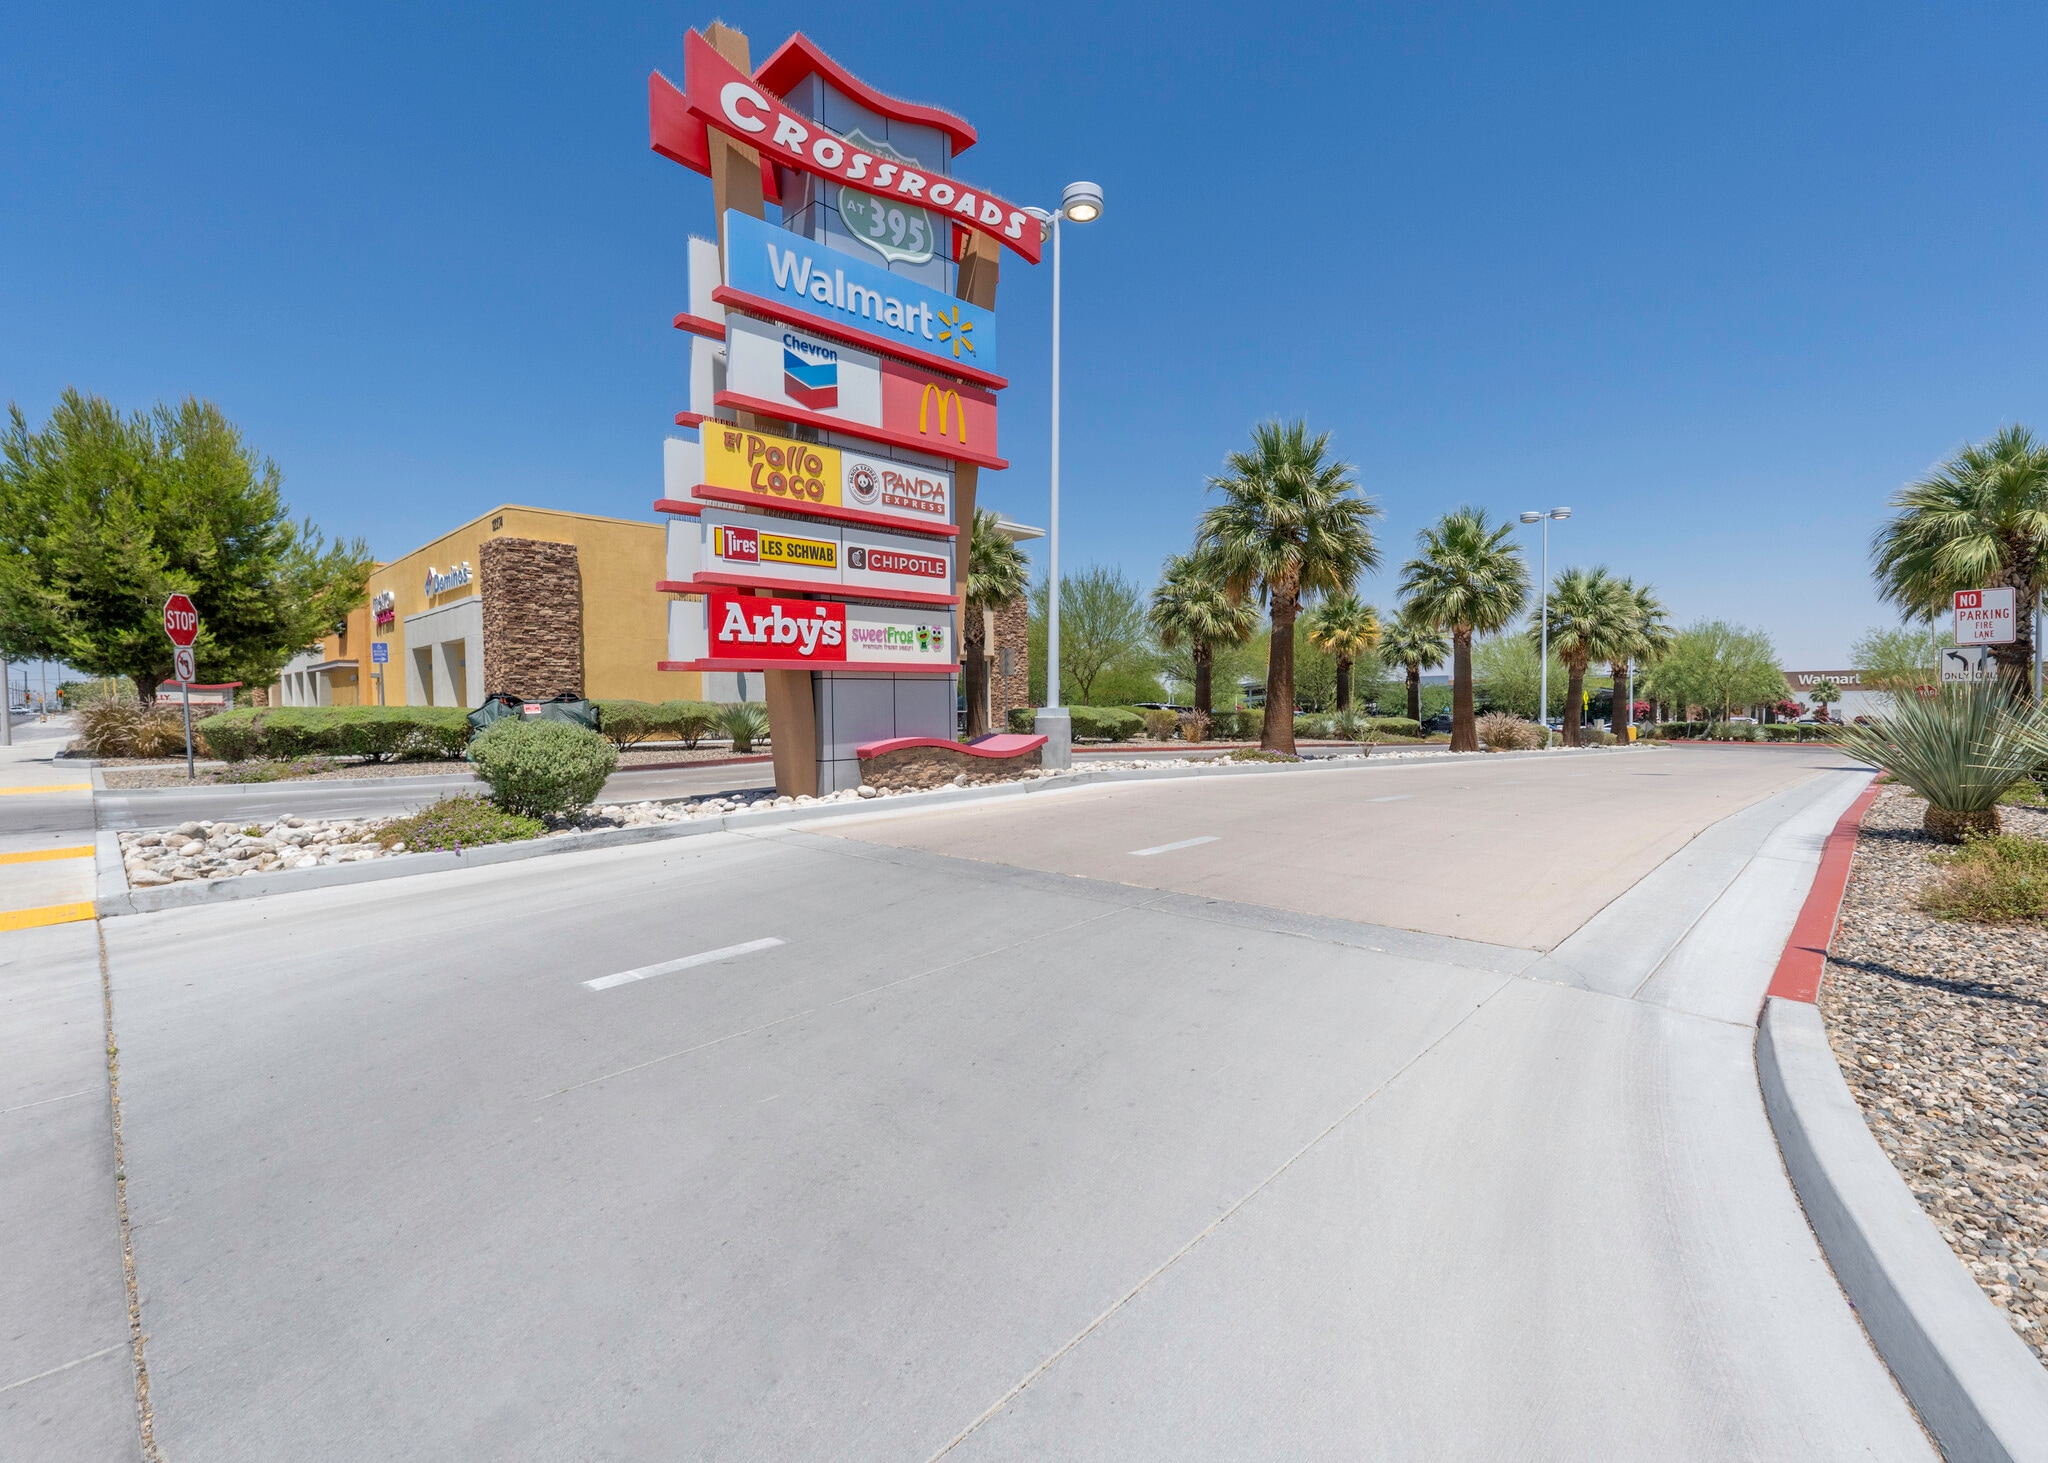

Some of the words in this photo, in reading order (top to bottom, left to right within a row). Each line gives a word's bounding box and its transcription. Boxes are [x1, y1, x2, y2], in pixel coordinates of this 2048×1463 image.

[721, 82, 1026, 240] CROSSROADS
[847, 200, 865, 214] AT
[869, 197, 925, 253] 395
[767, 243, 933, 339] Walmart
[783, 334, 838, 361] Chevron
[724, 432, 742, 450] El
[747, 434, 823, 475] Pollo
[881, 471, 945, 502] PANDA
[885, 495, 943, 513] EXPRESS
[725, 530, 757, 556] Tires
[761, 539, 783, 556] LES
[787, 542, 834, 562] SCHWAB
[871, 554, 944, 575] CHIPOTLE
[1959, 594, 1977, 608] NO
[167, 610, 196, 631] STOP
[1959, 608, 2010, 621] PARKING
[1975, 621, 1994, 629] FIRE
[719, 602, 842, 655] Arby's
[852, 626, 914, 644] sweetFrog
[1974, 629, 1995, 638] LANE
[1798, 674, 1861, 686] Walmart
[1945, 672, 1970, 680] ONLY
